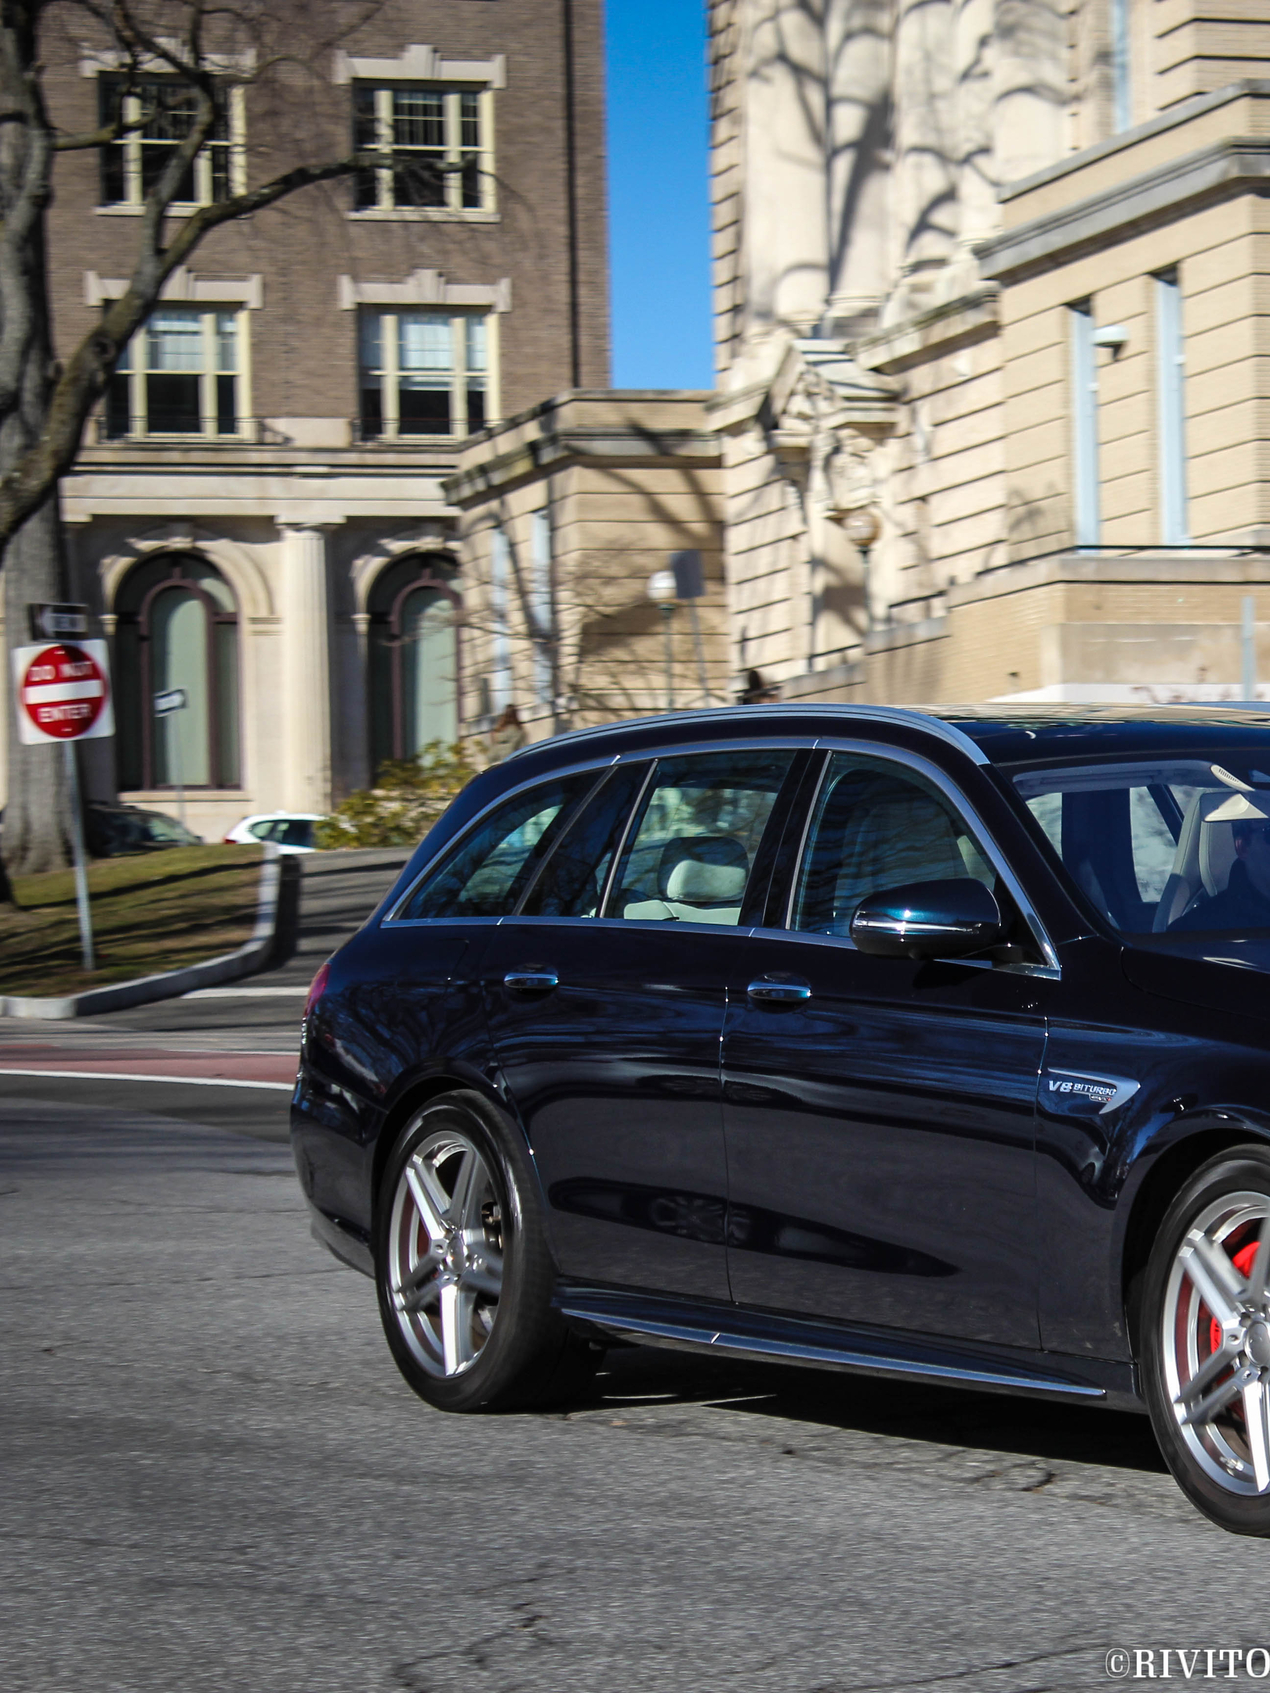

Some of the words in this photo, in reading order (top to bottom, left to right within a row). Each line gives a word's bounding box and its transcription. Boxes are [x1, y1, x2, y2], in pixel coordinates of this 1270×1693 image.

[29, 664, 56, 682] DO
[59, 661, 94, 678] NOT
[37, 703, 92, 723] ENTER
[1048, 1080, 1073, 1093] V8
[1073, 1084, 1117, 1095] BITURBO
